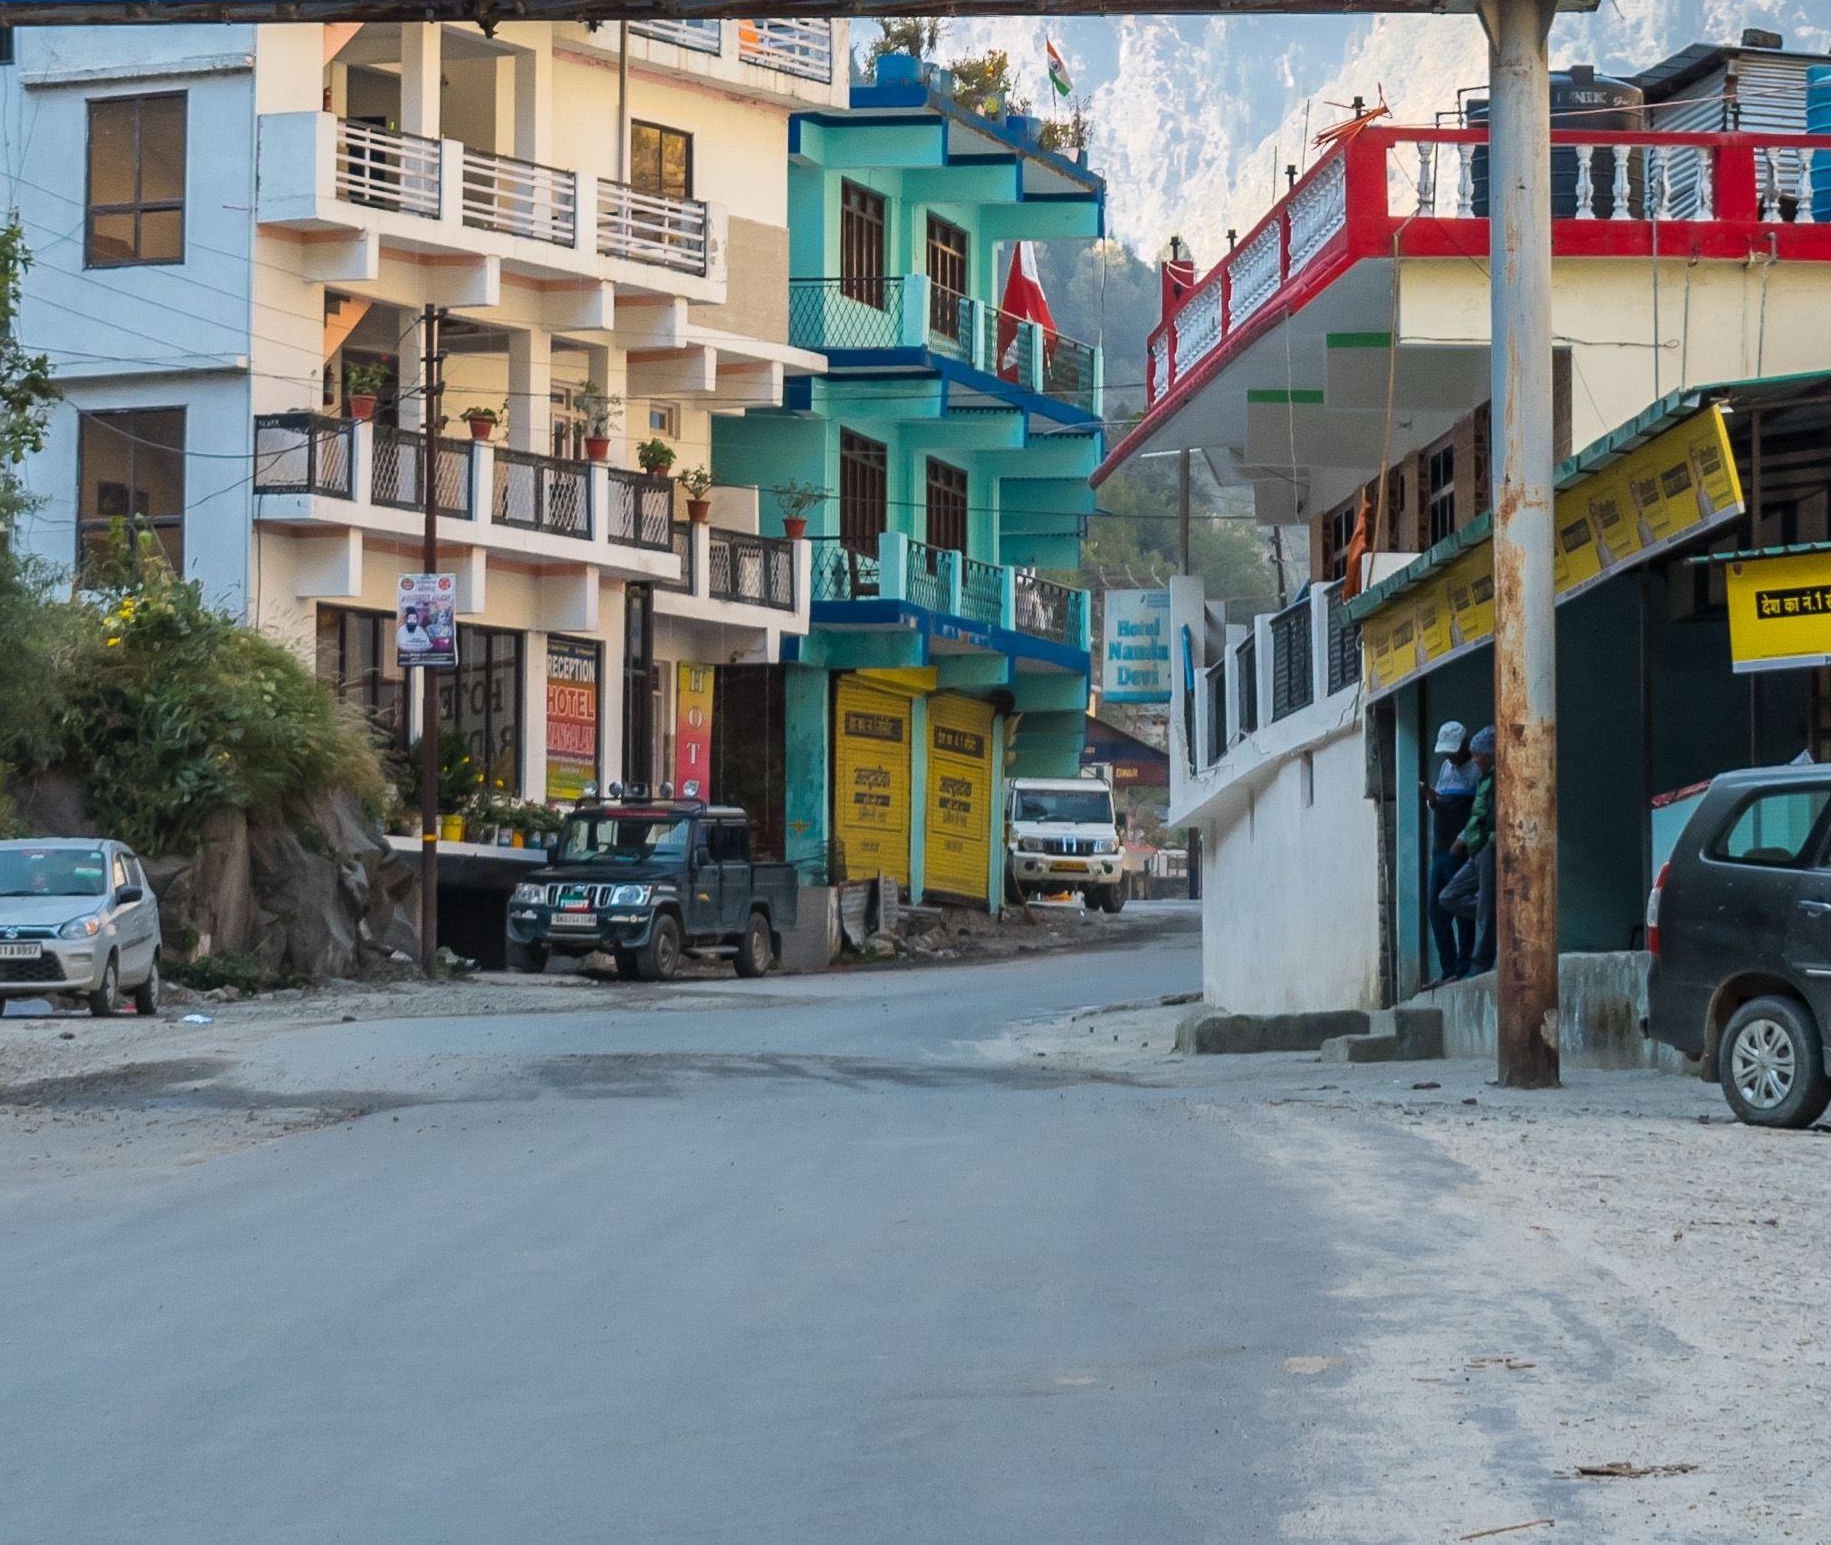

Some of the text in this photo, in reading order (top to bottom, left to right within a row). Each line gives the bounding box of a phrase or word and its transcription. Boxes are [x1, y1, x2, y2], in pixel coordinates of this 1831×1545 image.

[1761, 593, 1780, 615] देश
[1783, 597, 1799, 612] का
[1117, 618, 1160, 637] Hotel
[547, 654, 596, 683] RECEPTION
[1117, 662, 1160, 686] Devi
[547, 686, 595, 719] HOTEL
